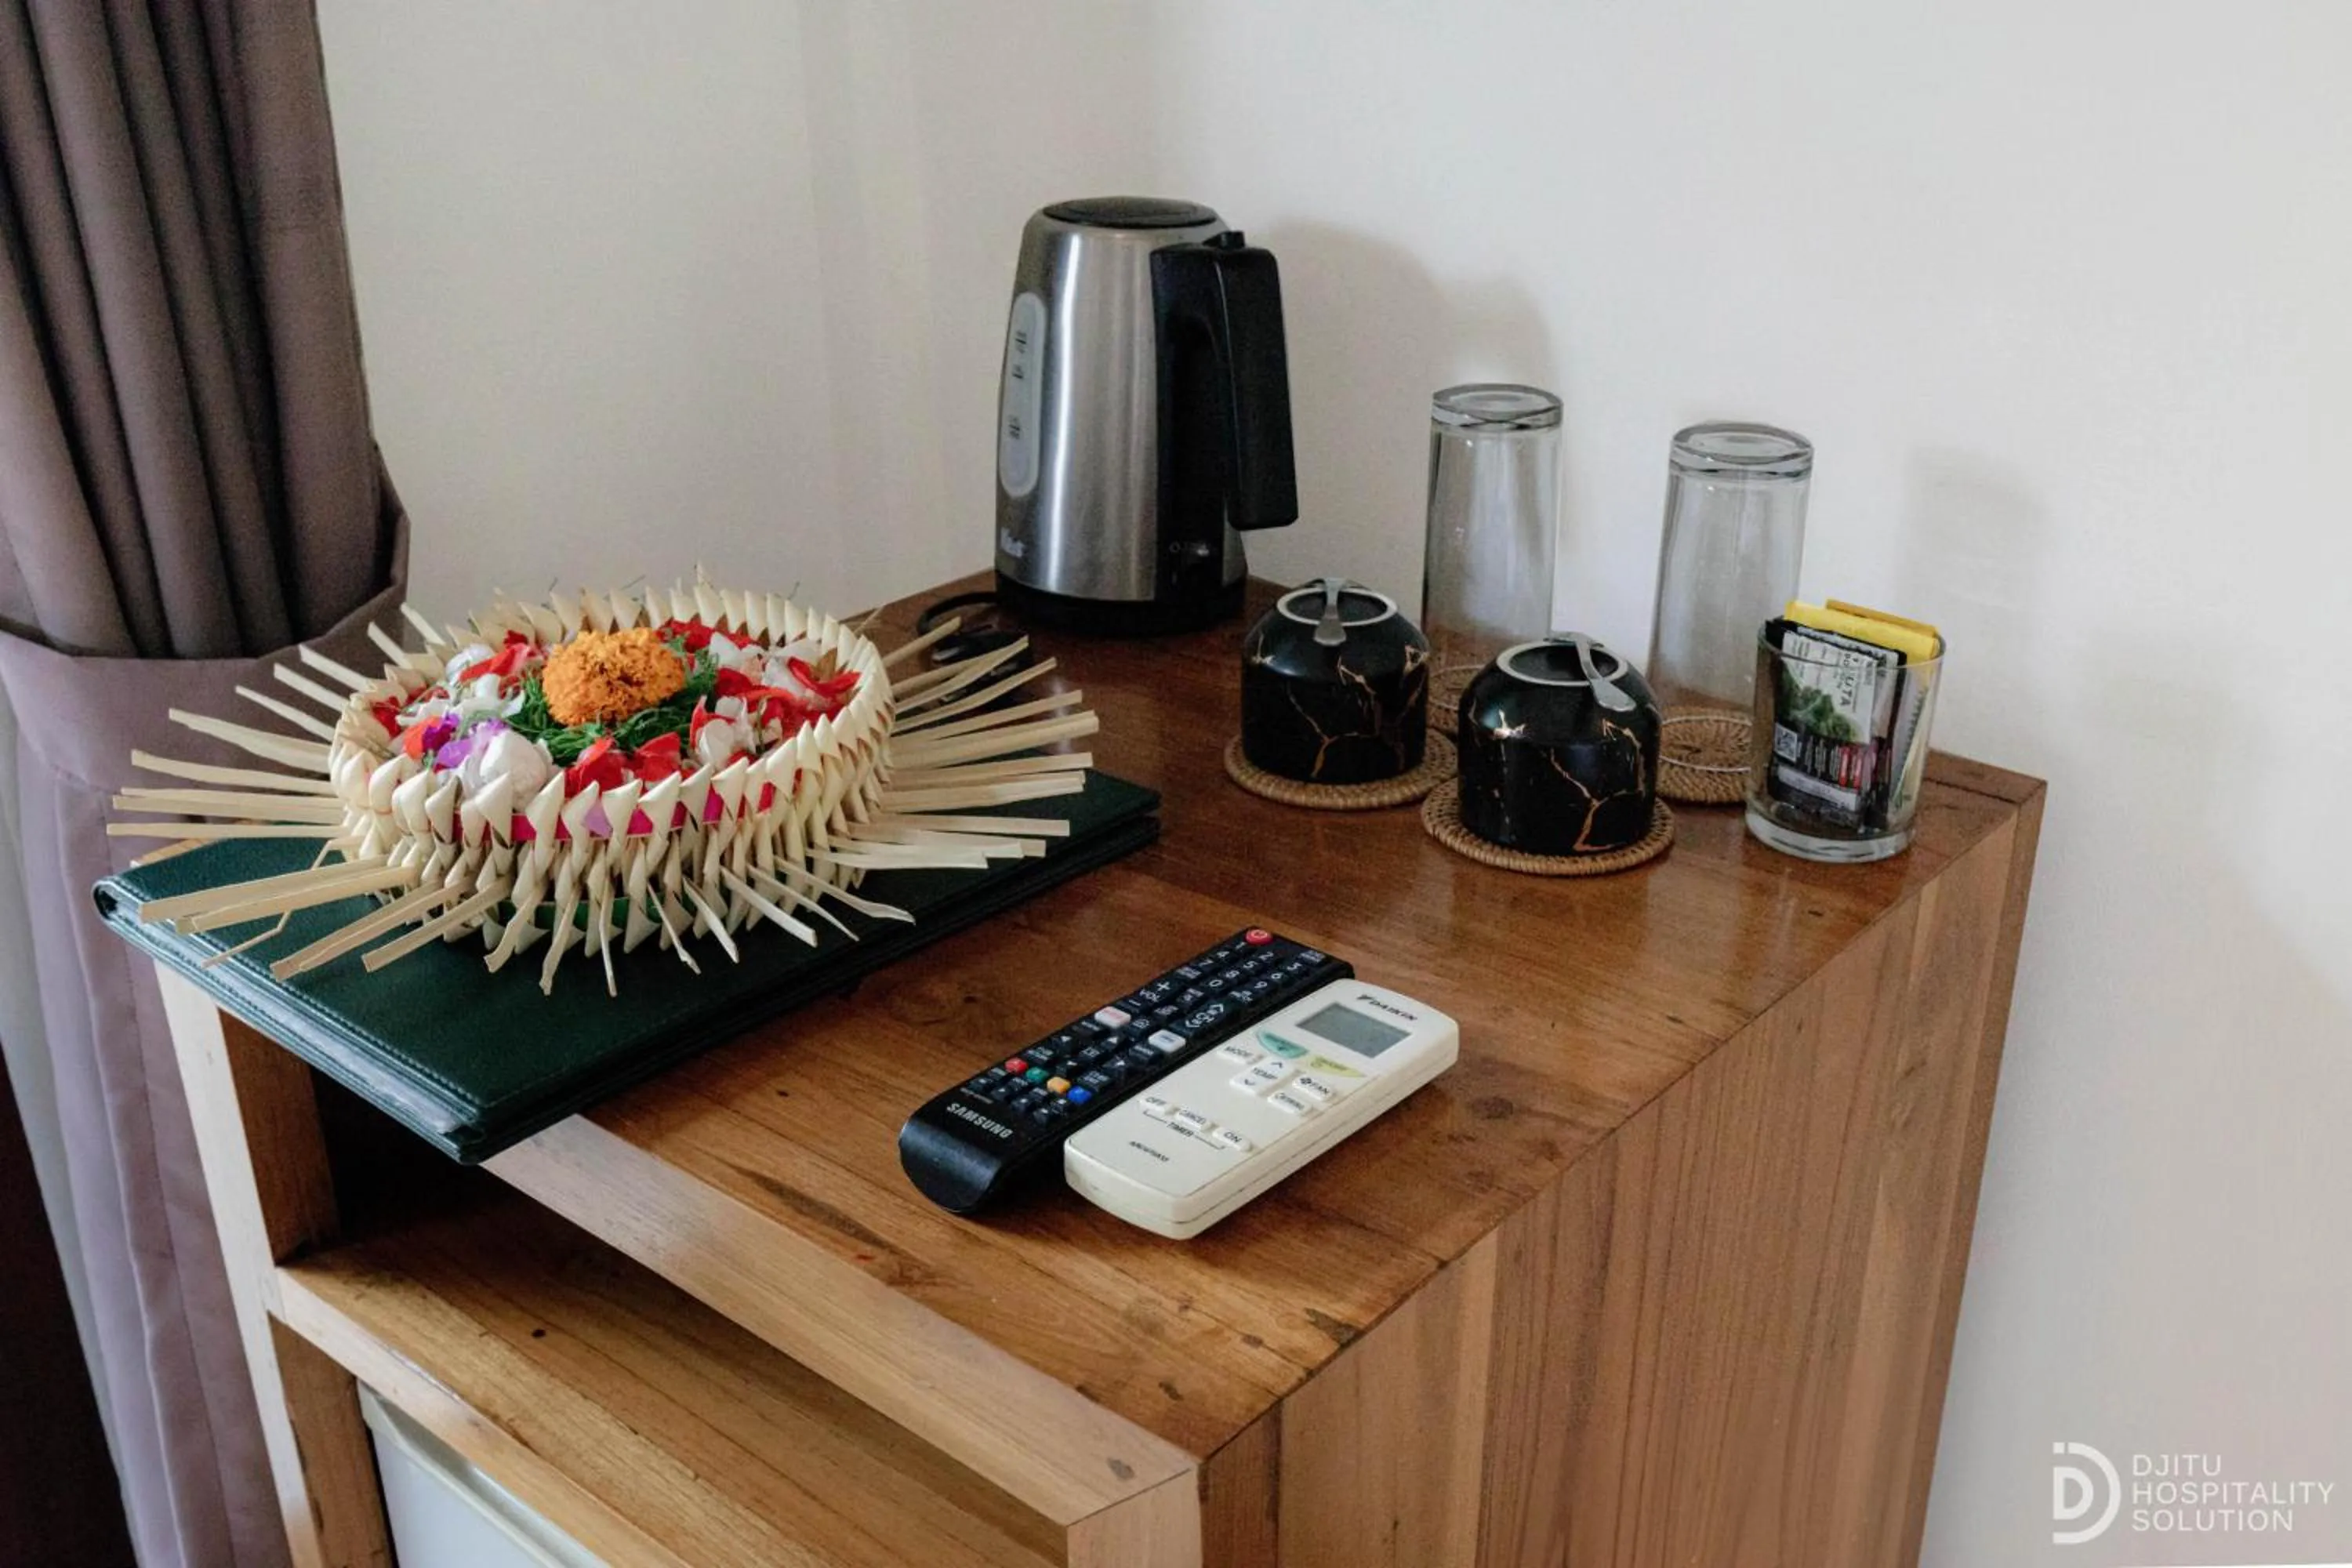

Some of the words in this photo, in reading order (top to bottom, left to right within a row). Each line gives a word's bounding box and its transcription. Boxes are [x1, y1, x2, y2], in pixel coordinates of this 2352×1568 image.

[1258, 951, 1274, 961] 2
[1139, 989, 1161, 1003] VOL
[1368, 999, 1417, 1021] DAIKIN
[1224, 1045, 1254, 1058] MODE
[1251, 1067, 1279, 1080] TEMP
[1310, 1082, 1330, 1094] FAN
[1145, 1096, 1167, 1106] OFF
[947, 1102, 1013, 1139] SAMSUNG
[1178, 1109, 1207, 1124] CANCEL
[1167, 1121, 1193, 1138] TIMER
[1223, 1131, 1242, 1143] ON
